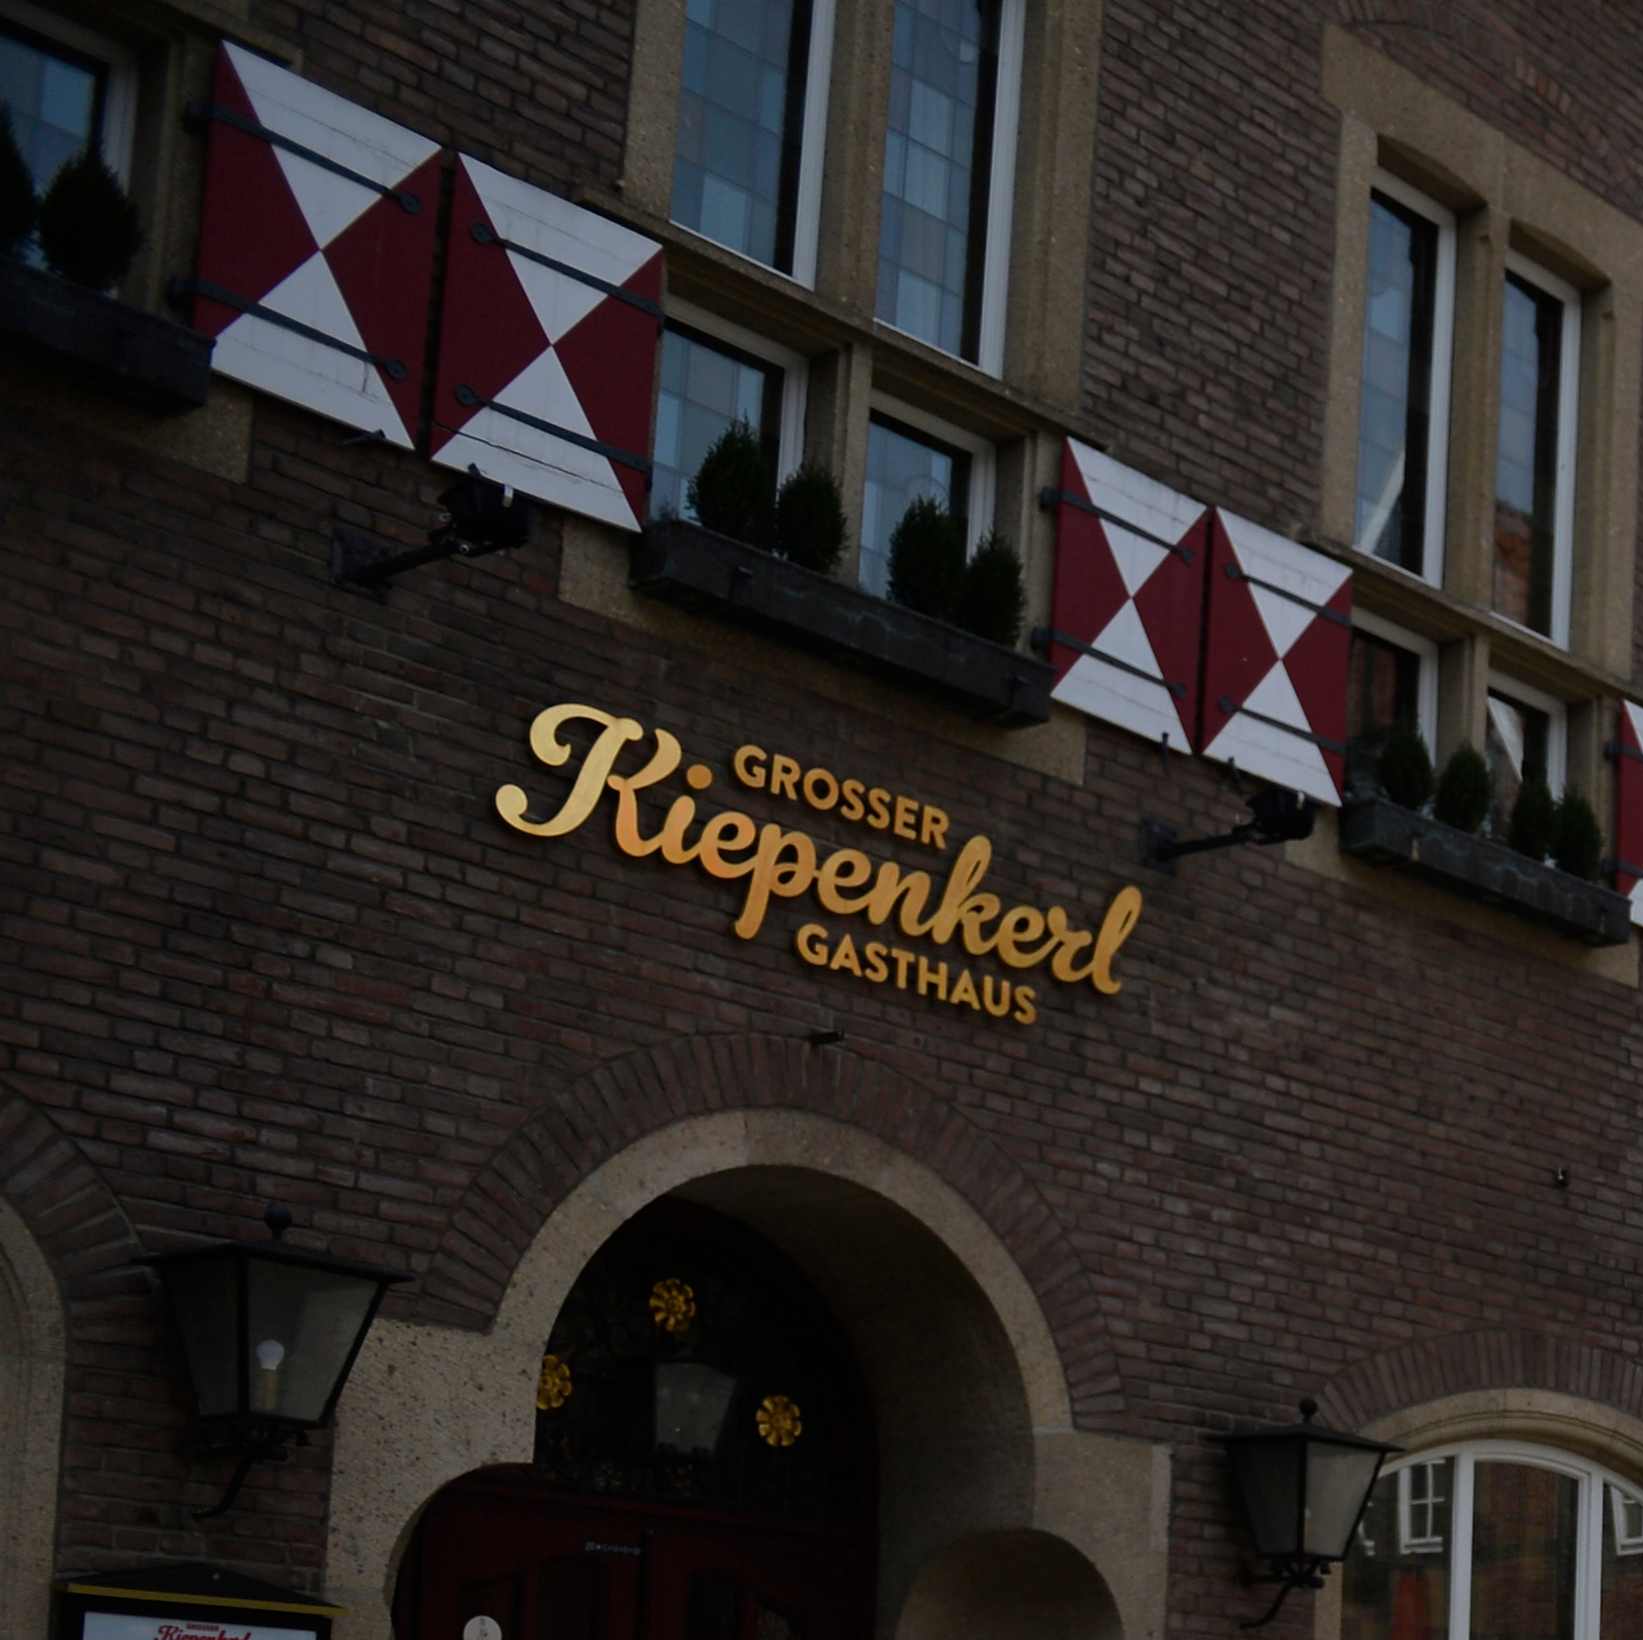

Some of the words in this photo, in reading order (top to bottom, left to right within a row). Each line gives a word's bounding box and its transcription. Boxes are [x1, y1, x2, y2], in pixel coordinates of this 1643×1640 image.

[495, 702, 1144, 995] Kiepenkerl
[734, 744, 950, 850] GROSSER
[797, 923, 1038, 1025] GASTHAUS
